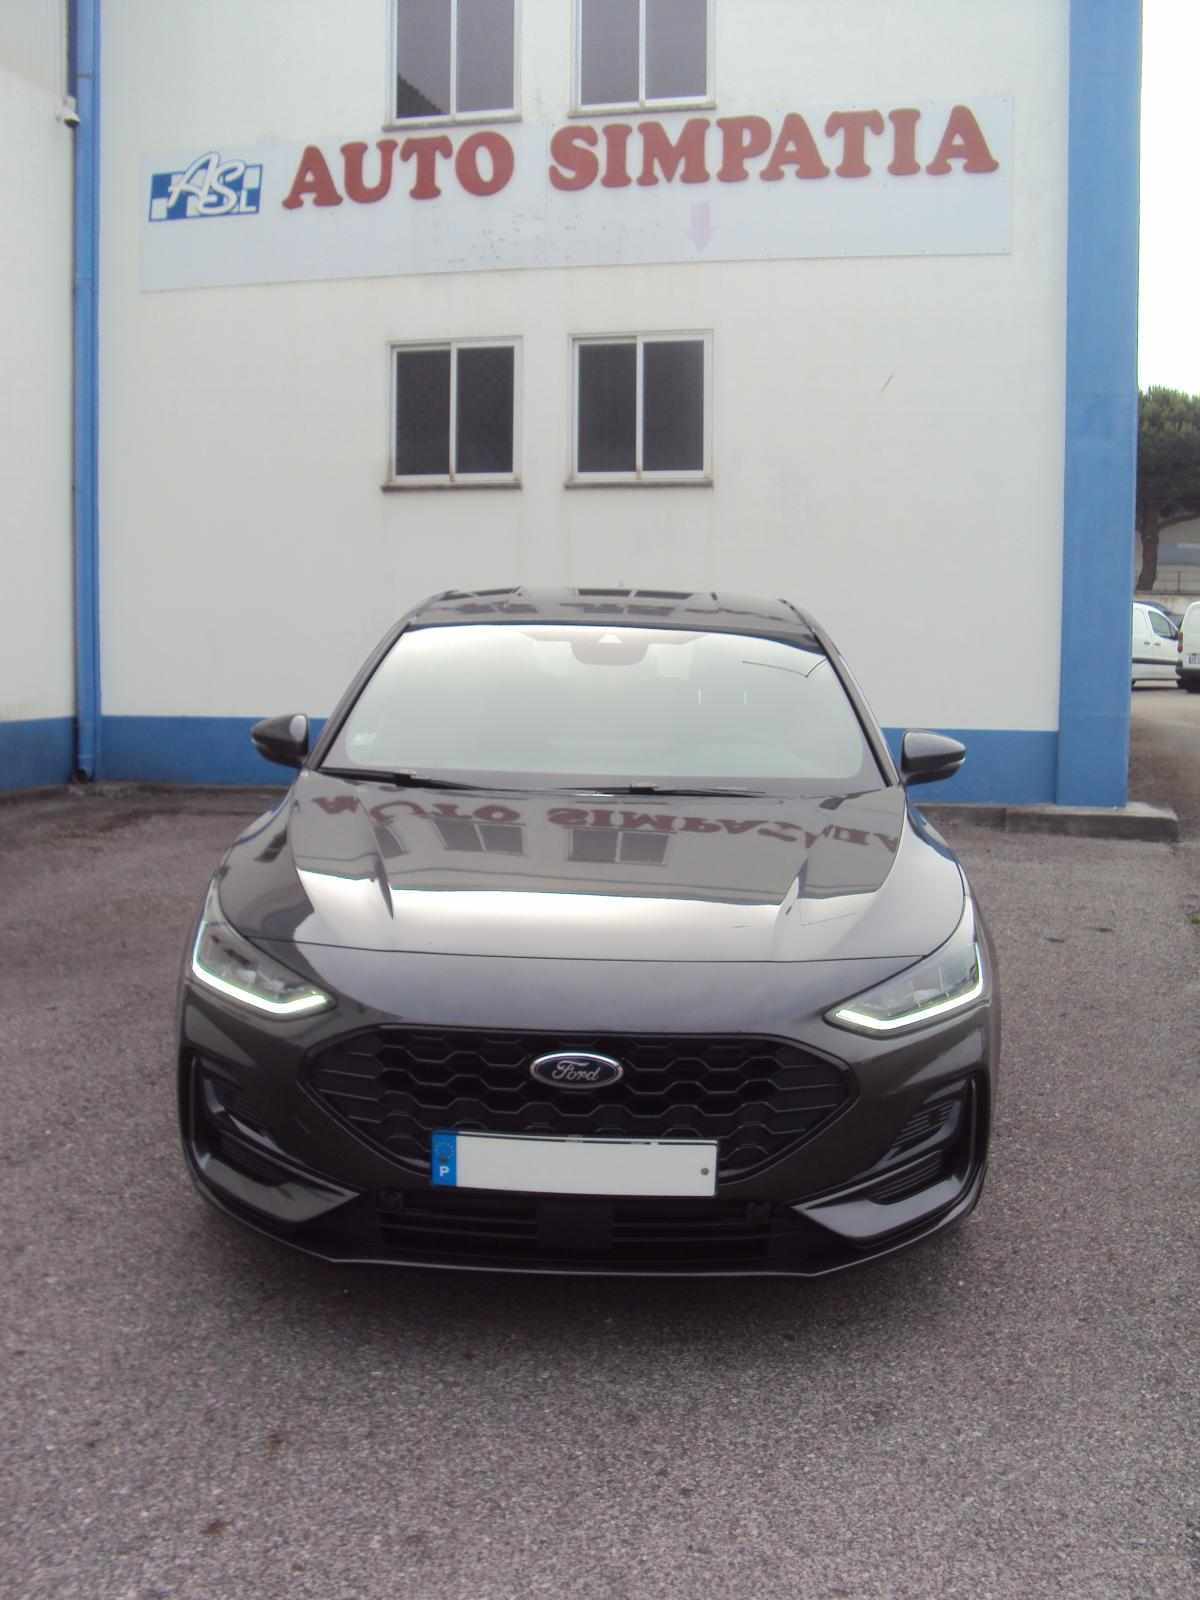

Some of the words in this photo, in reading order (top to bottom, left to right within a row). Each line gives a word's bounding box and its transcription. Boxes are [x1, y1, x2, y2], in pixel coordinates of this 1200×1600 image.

[283, 131, 514, 209] AUTO
[549, 105, 999, 191] SIMPATIA
[551, 1060, 601, 1081] Ford
[439, 1165, 450, 1177] P
